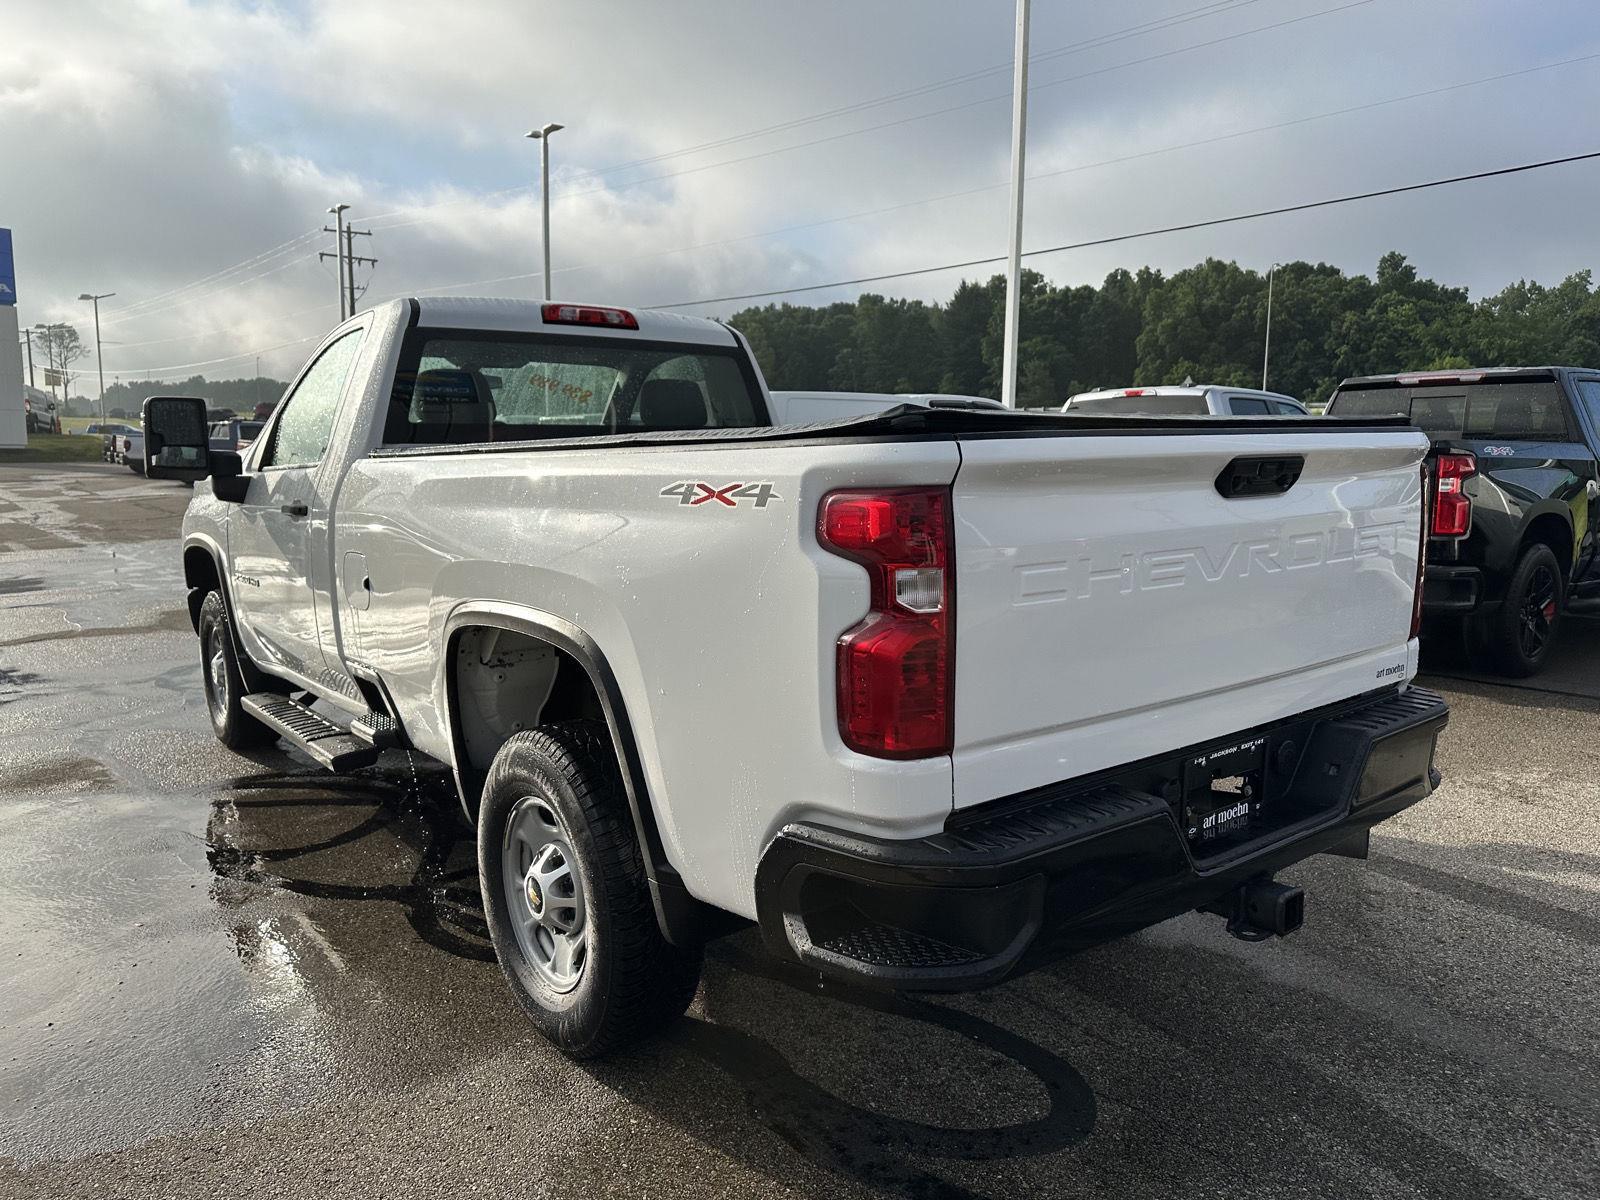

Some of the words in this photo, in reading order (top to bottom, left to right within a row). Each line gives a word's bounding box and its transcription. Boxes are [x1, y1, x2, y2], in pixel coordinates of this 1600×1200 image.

[1012, 520, 1407, 607] CHEVROLET
[1376, 668, 1385, 678] art
[1241, 741, 1254, 750] EXIT
[1254, 738, 1264, 746] 141
[1203, 813, 1216, 829] art
[1218, 802, 1249, 824] moehn
